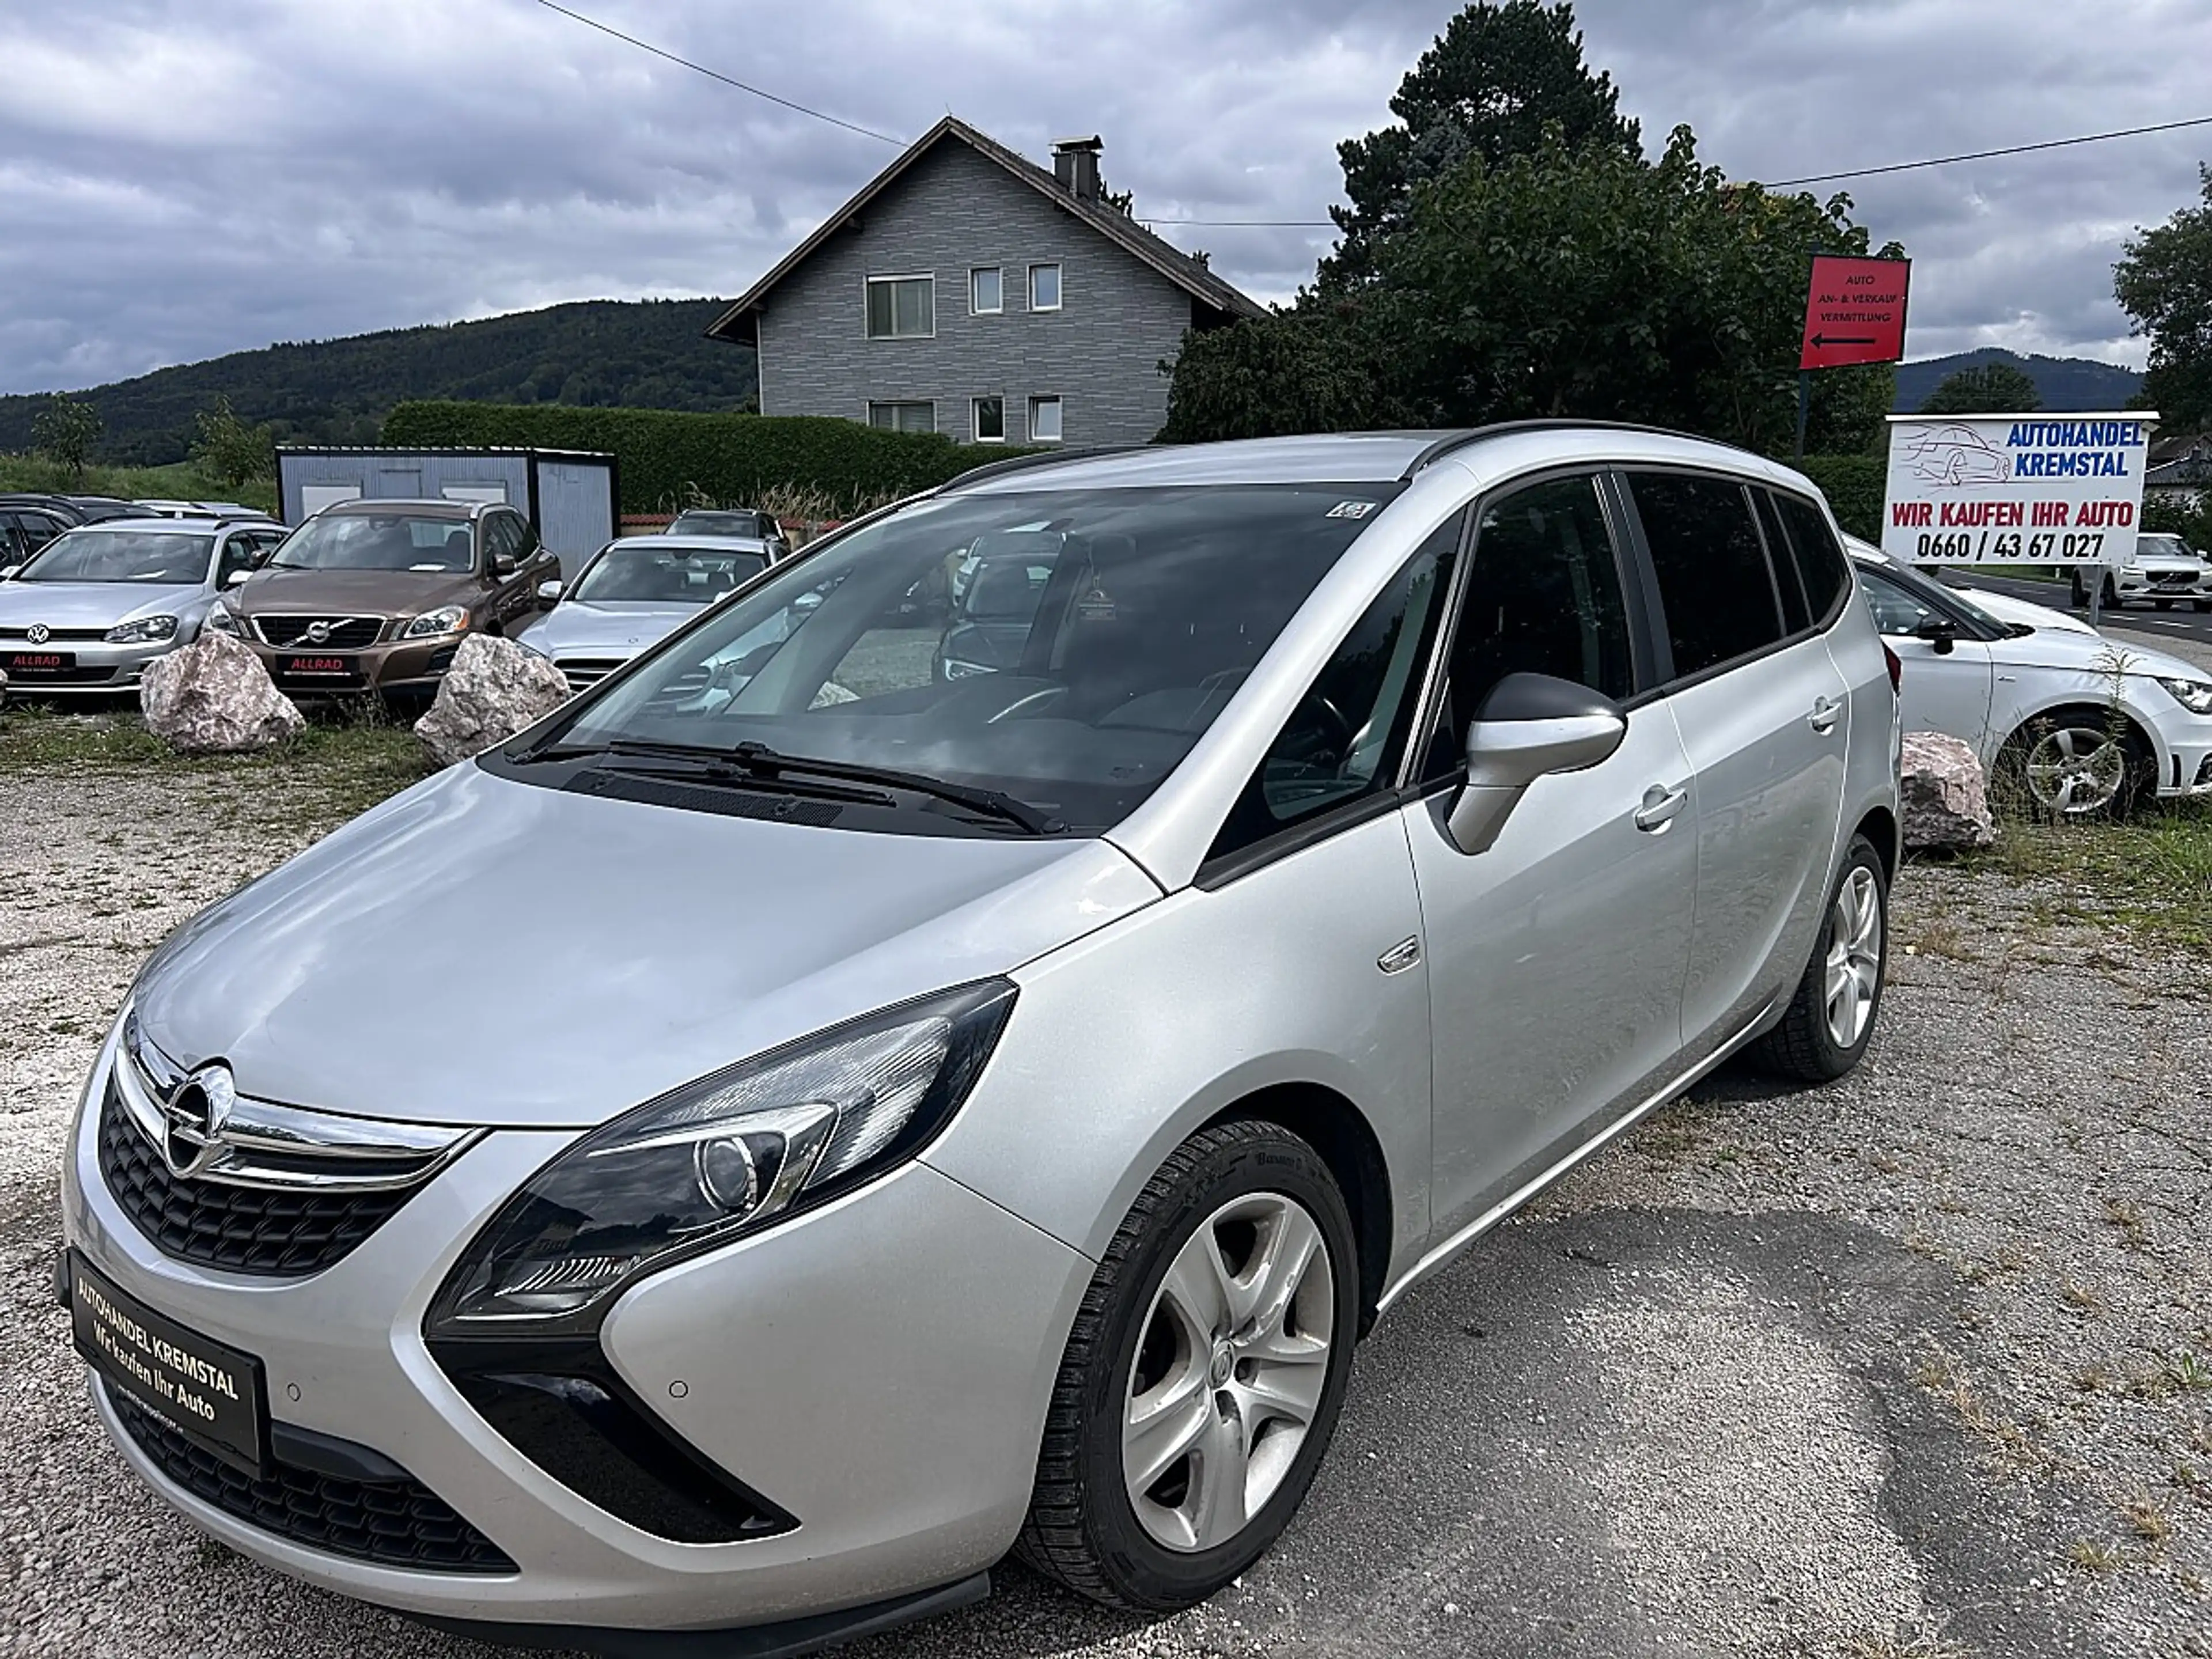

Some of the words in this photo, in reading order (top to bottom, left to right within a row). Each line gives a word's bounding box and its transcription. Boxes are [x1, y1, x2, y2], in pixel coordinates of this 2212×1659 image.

[1845, 276, 1874, 285] AUTO
[1818, 294, 1837, 303] AN-
[1853, 294, 1896, 303] VERKAUF
[1821, 313, 1891, 321] VERMITTLUNG
[2006, 422, 2144, 446] AUTOHANDEL
[2015, 452, 2128, 476] KREMSTAL
[1893, 503, 1932, 527] WIR
[1940, 502, 2024, 527] KAUFEN
[2031, 502, 2069, 526] IHR
[2075, 501, 2133, 526] AUTO
[1917, 533, 1971, 558] 0660
[1976, 531, 1988, 561] /
[1993, 533, 2021, 558] 43
[2028, 533, 2055, 558] 67
[2062, 533, 2104, 558] 027
[13, 655, 60, 666] ALLRAD
[291, 658, 343, 669] ALLRAD
[79, 1277, 151, 1354] AUTOHANDEL
[153, 1336, 238, 1400] KREMSTAL
[93, 1320, 111, 1352] Wir
[112, 1336, 151, 1385] kaufen
[154, 1369, 173, 1398] Ihr
[177, 1384, 215, 1421] Auto
